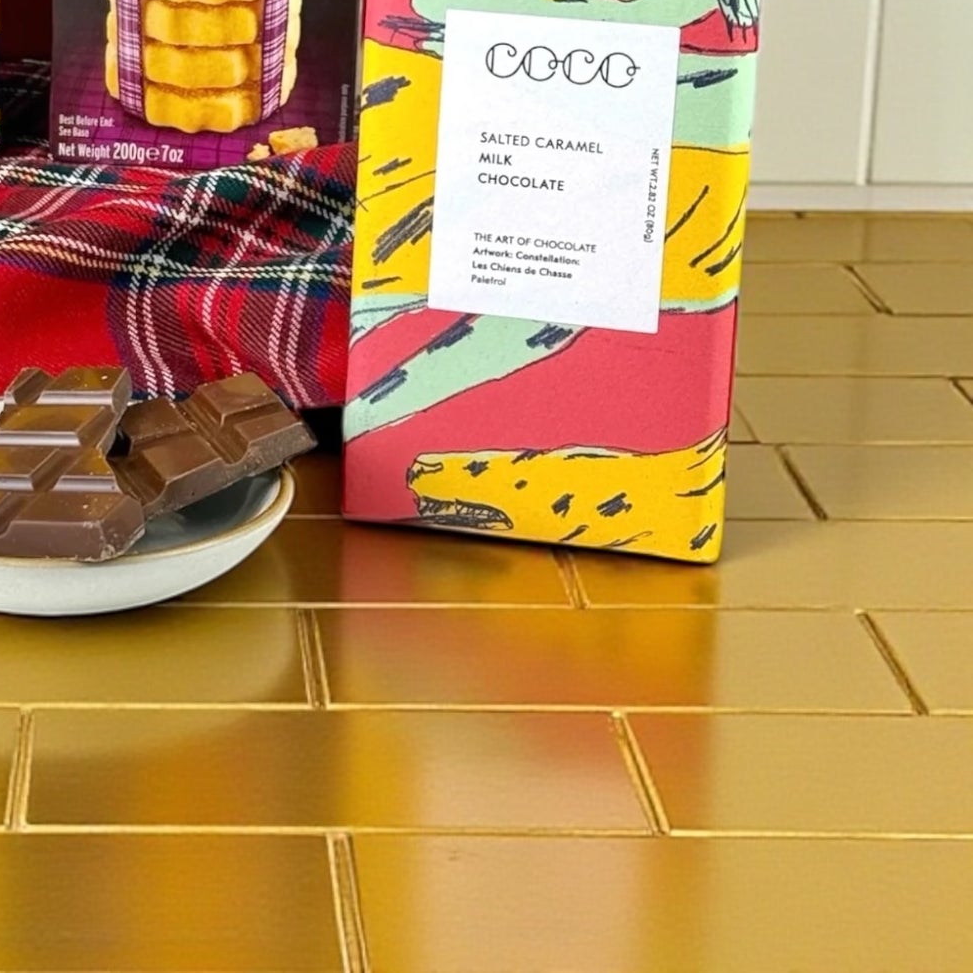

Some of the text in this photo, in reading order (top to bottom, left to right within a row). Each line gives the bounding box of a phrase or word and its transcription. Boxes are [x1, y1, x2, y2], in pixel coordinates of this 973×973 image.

[58, 114, 75, 125] Best
[75, 115, 99, 127] Before
[58, 126, 71, 136] See
[480, 131, 603, 154] SALTED CARAMEL
[58, 143, 76, 157] Net
[77, 144, 111, 160] Weight
[479, 153, 512, 166] MILK
[651, 148, 659, 165] NET
[477, 173, 565, 191] CHOCOLATE
[647, 204, 656, 218] OZ
[474, 232, 597, 253] THE ART OF CHOCOLATE
[473, 247, 580, 266] Artwork: Constellation:
[472, 261, 572, 279] Les Chiens de Chasse
